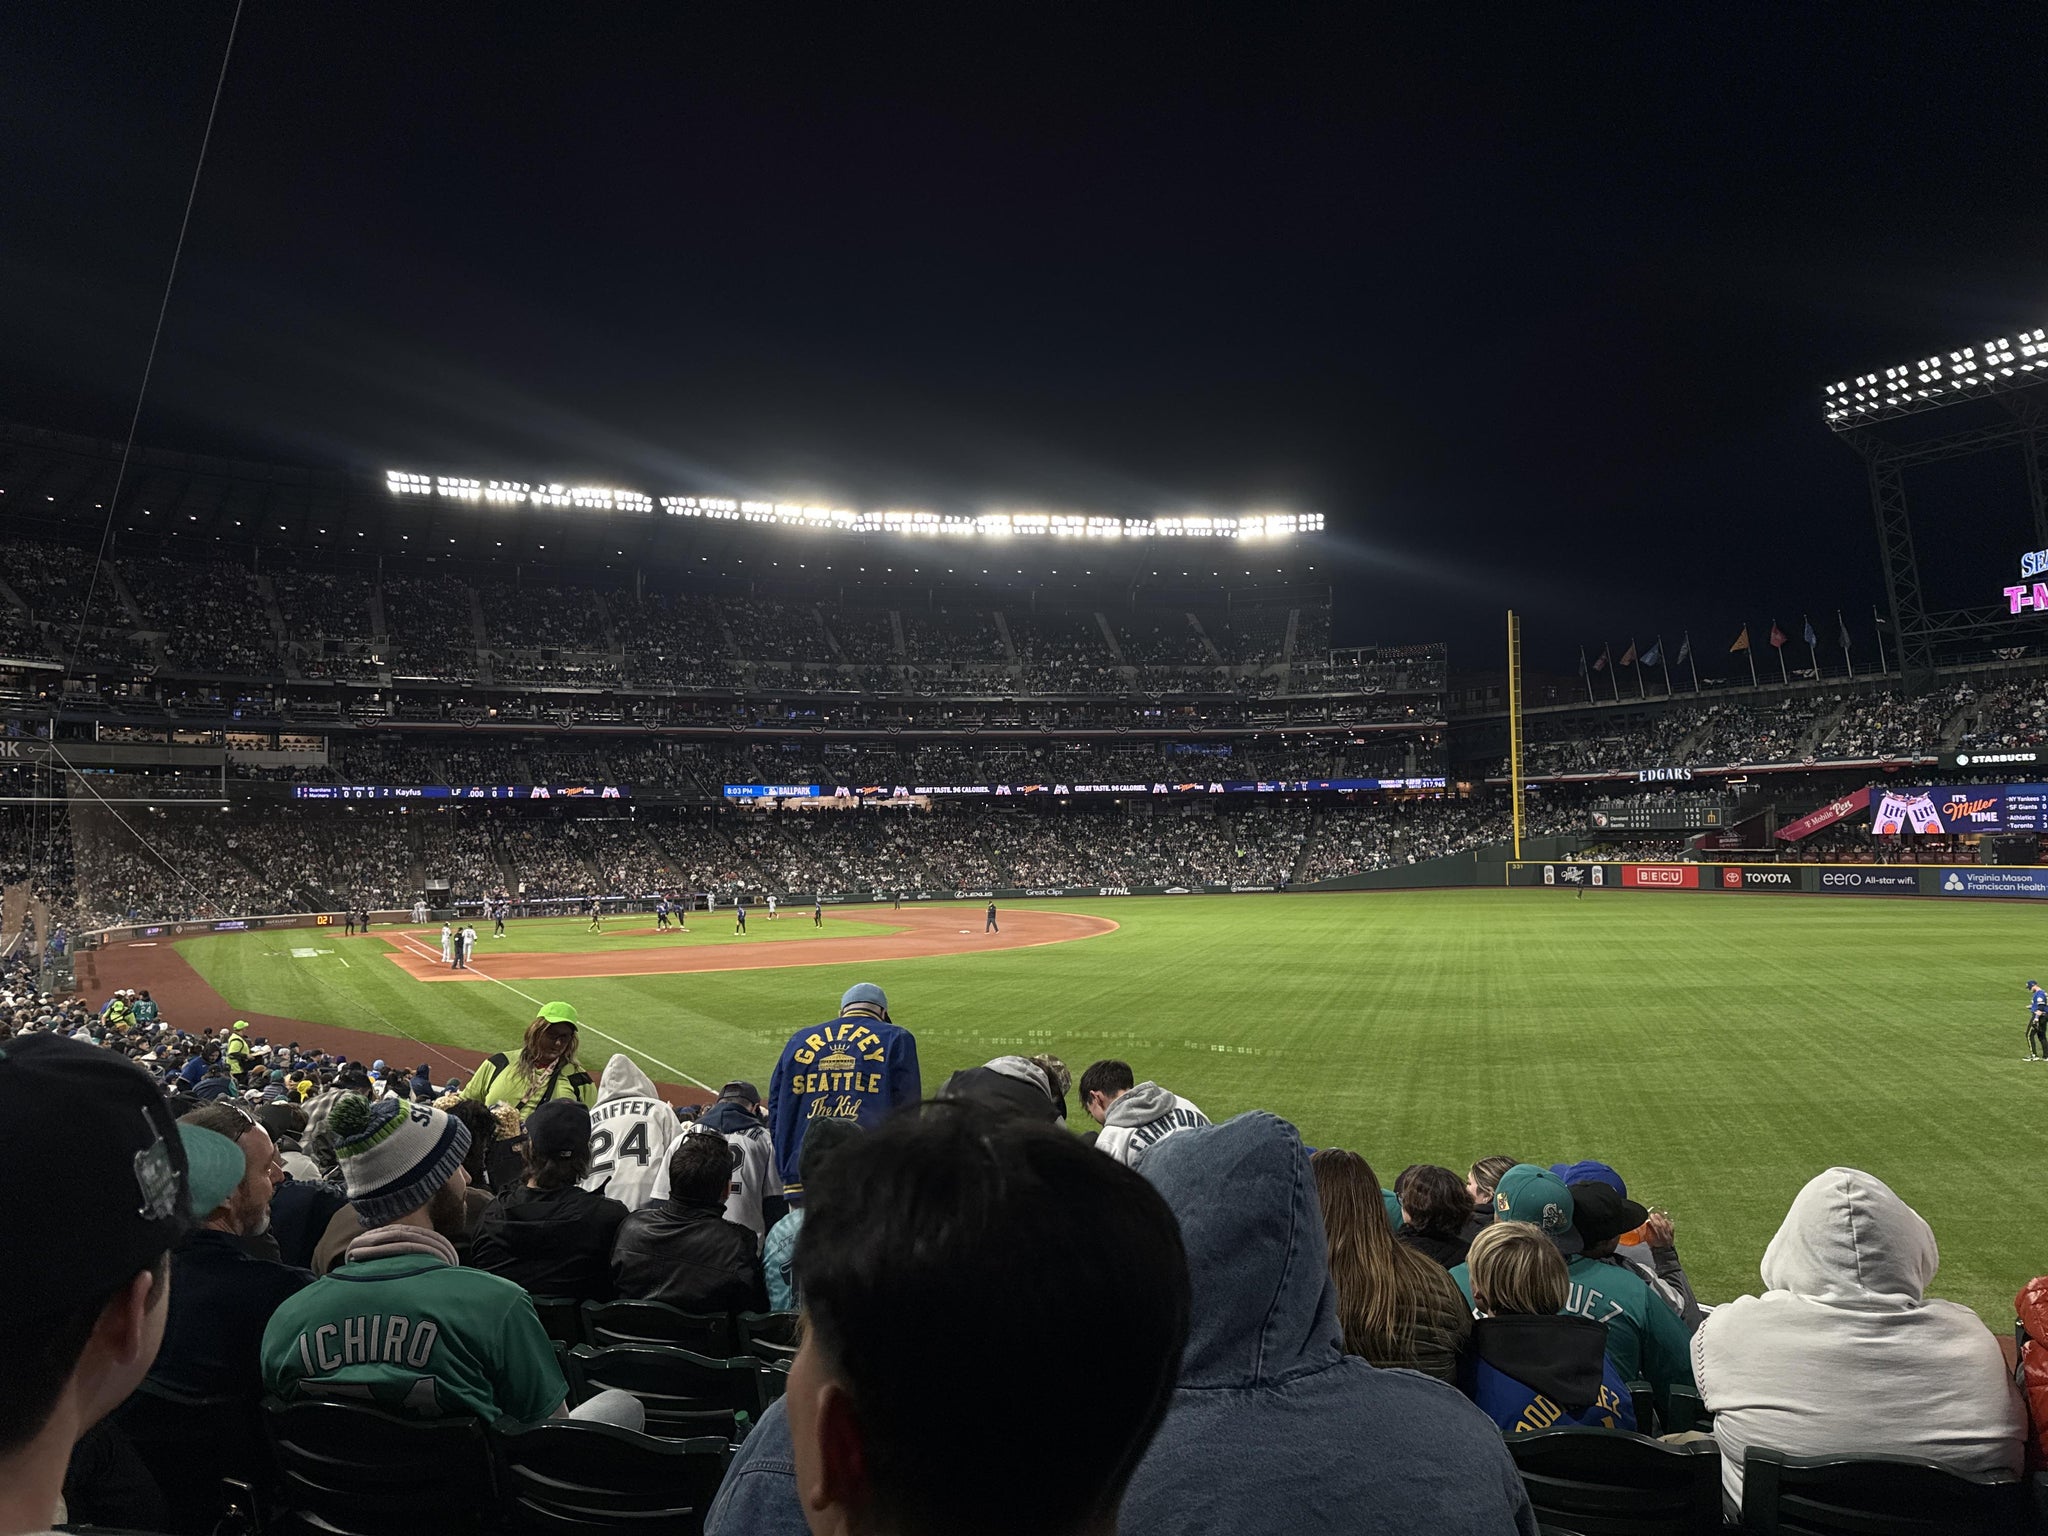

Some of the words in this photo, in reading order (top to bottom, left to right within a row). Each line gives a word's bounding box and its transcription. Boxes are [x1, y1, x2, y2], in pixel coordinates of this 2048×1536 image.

[1972, 753, 2036, 764] STARBUCKS
[343, 790, 350, 798] 0
[356, 790, 362, 798] 0
[368, 790, 375, 798] 0
[383, 788, 389, 796] 2
[395, 788, 421, 796] Kayfus
[491, 790, 497, 798] 0
[508, 790, 514, 798] 0
[727, 787, 741, 795] 8:03
[742, 787, 753, 795] PM
[779, 786, 811, 795] BALLPARK
[1952, 794, 1967, 802] IT'S
[1811, 811, 1834, 826] Mobile
[1830, 799, 1854, 817] Pen
[1883, 804, 1906, 819] Lite
[1912, 804, 1935, 823] Lite
[1943, 798, 1998, 822] Miller
[1970, 812, 1999, 822] TIME
[1640, 870, 1681, 882] BECU
[1746, 873, 1791, 884] TOYOTA
[1822, 873, 1862, 886] eero
[1865, 876, 1895, 885] All-star
[1897, 876, 1916, 885] wifi.
[1967, 873, 2000, 883] Virginia
[2001, 874, 2033, 882] Mason
[1099, 888, 1131, 896] STIHL
[1968, 882, 2016, 891] Franciscan
[2017, 883, 2046, 891] Health
[1026, 889, 1046, 897] Great
[1046, 888, 1064, 896] Clips
[316, 915, 333, 925] 021
[793, 1023, 885, 1065] GRIFFEY
[792, 1072, 882, 1095] SEATTLE
[591, 1101, 656, 1125] RIFFEY
[807, 1094, 832, 1119] The
[833, 1095, 863, 1122] Kid
[589, 1121, 652, 1177] 24
[299, 1314, 439, 1377] ICHIRO
